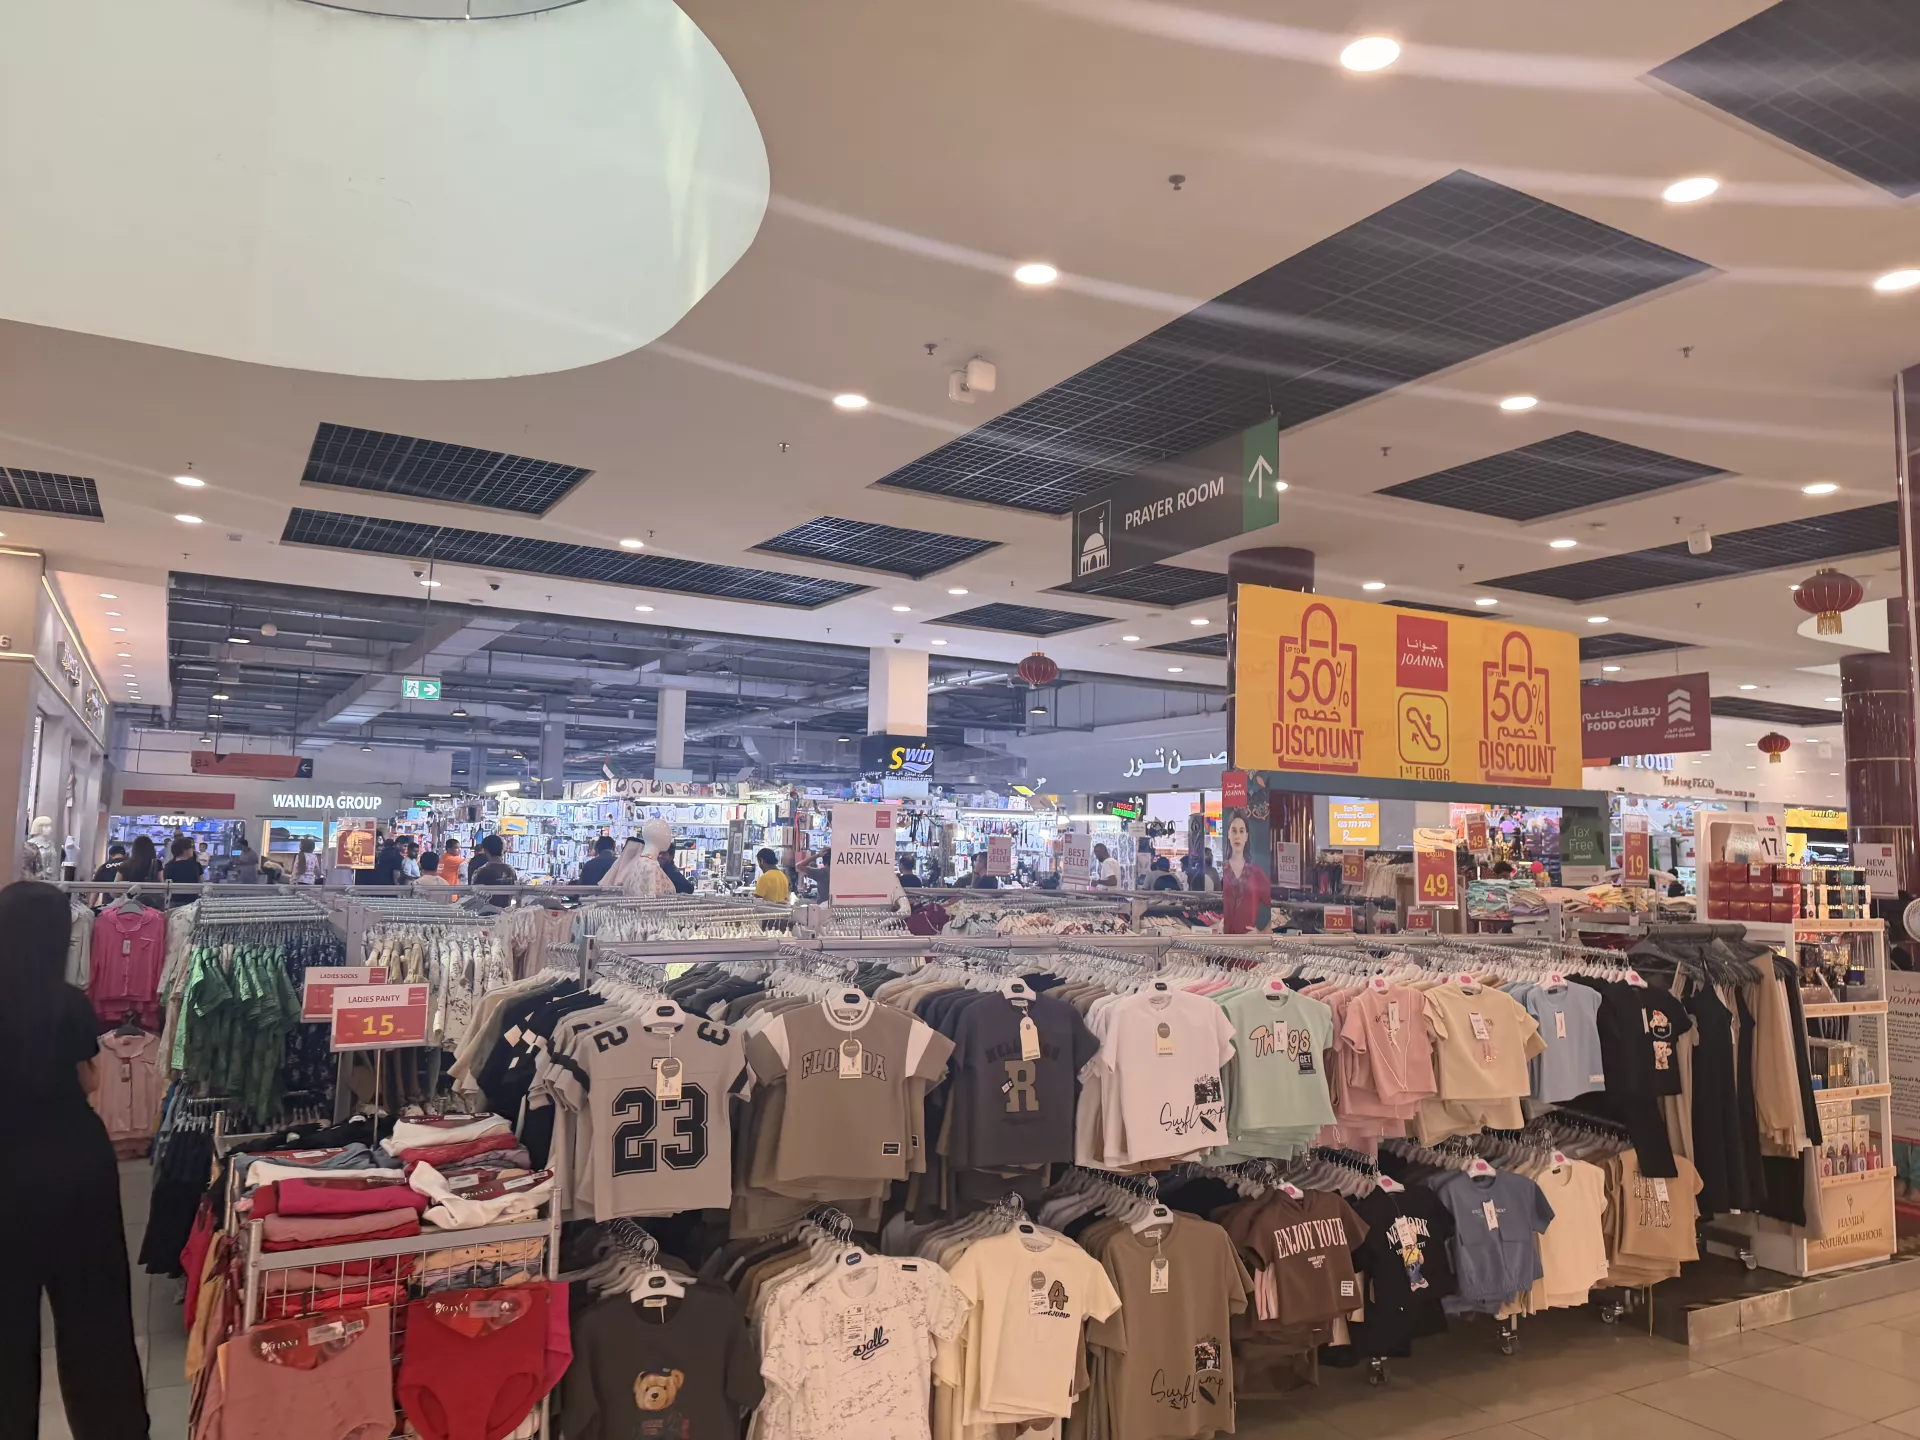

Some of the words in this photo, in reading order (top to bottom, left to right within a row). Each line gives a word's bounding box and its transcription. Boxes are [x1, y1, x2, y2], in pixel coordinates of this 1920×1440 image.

[1125, 497, 1173, 530] PRAYER
[1177, 476, 1224, 511] ROOM
[1406, 637, 1438, 653] جوانا
[1400, 652, 1444, 668] JOANNA
[1286, 656, 1350, 707] 50%
[1490, 679, 1544, 727] 50%
[1294, 706, 1341, 723] خصم
[1582, 707, 1631, 723] المطاعم
[1632, 706, 1661, 717] ردهة
[1587, 720, 1617, 732] FOOD
[1619, 717, 1656, 729] COURT
[1497, 725, 1538, 740] خصم
[1272, 722, 1364, 760] DISCOUNT
[1123, 747, 1165, 777] تور
[1479, 740, 1556, 774] DISCOUNT
[1399, 765, 1413, 778] 1st
[1415, 766, 1450, 781] FLOOR
[1663, 776, 1692, 790] Trading
[1224, 789, 1246, 797] JOANNA
[273, 794, 335, 809] WANLIDA
[336, 795, 382, 810] GROUP
[159, 815, 195, 826] CCTV
[1571, 825, 1590, 838] Tax
[850, 833, 880, 846] NEW
[1471, 836, 1483, 848] 49
[1569, 838, 1594, 851] Free
[1761, 837, 1778, 857] 17
[836, 852, 890, 865] ARRIVAL
[989, 855, 1010, 863] SELLER
[992, 848, 1007, 856] BEST
[1068, 847, 1086, 857] BEST
[1281, 855, 1296, 863] BEST
[1064, 857, 1089, 867] SELLER
[1279, 864, 1298, 872] SELLER
[1628, 855, 1644, 876] 19
[1866, 859, 1886, 867] NEW
[1344, 865, 1358, 876] 39
[1865, 868, 1895, 878] RRIVAL
[1423, 874, 1448, 897] 49
[1333, 918, 1343, 927] 20
[1415, 918, 1424, 926] 15
[348, 995, 374, 1004] LADIES
[375, 995, 400, 1003] PANTY
[1888, 995, 1920, 1006] JOANN
[363, 1014, 394, 1036] 15
[1249, 1025, 1310, 1062] Thgs
[801, 1048, 887, 1081] FLODA
[1300, 1054, 1312, 1063] GET
[1004, 1060, 1039, 1113] R
[612, 1082, 708, 1177] 23
[1407, 1216, 1431, 1238] ORK
[1274, 1221, 1316, 1259] ENJOY
[1315, 1217, 1347, 1248] YOUR
[1820, 1234, 1849, 1250] NATURAL
[1850, 1228, 1883, 1243] BAKHOOR
